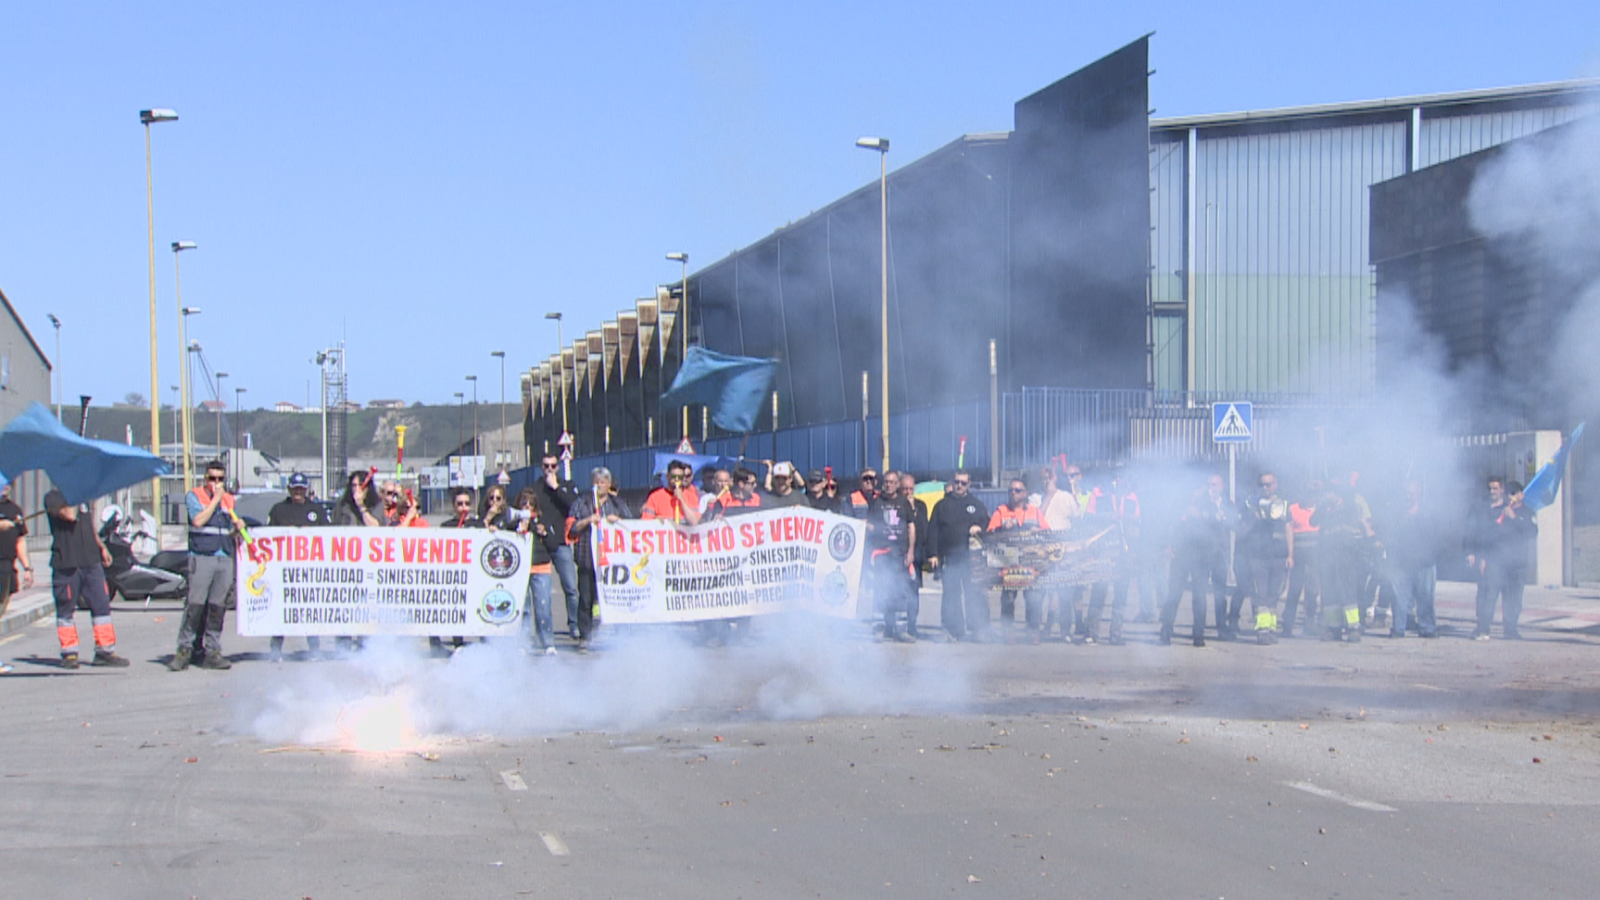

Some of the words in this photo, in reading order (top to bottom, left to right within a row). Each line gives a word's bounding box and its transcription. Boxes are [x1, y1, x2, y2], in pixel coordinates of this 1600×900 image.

[602, 528, 626, 553] LA
[631, 529, 703, 555] ESTIBA
[707, 525, 736, 553] NO
[740, 521, 765, 548] SE
[769, 516, 825, 544] VENDE
[331, 536, 363, 563] NO
[368, 536, 396, 563] SE
[401, 537, 473, 564] VENDE
[282, 567, 364, 583] EVENTUALIDAD
[376, 568, 468, 585] SINIESTRALIDAD
[665, 555, 741, 576] EVENTUALIDAD
[665, 570, 744, 592] PRIVATIZACIÓN
[283, 585, 368, 603] PRIVATIZACIÓN
[376, 586, 467, 605] LIBERALIZACIÓN
[666, 587, 748, 611] LIBERALIZACIÓN
[283, 604, 370, 624] LIBERALIZACIÓN
[377, 605, 466, 625] PRECARIZACIÓN
